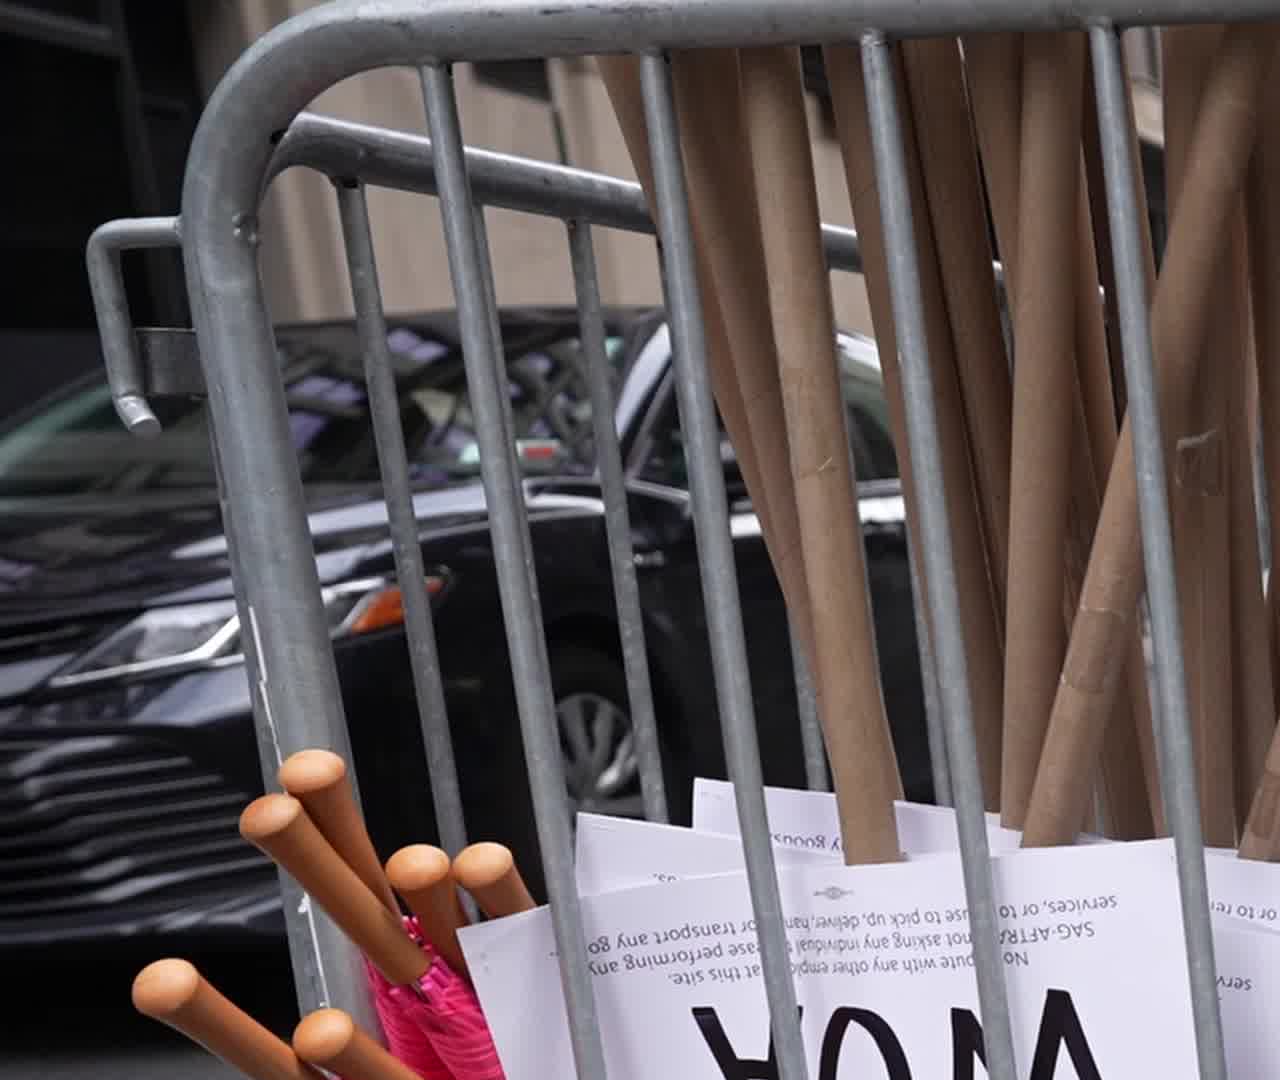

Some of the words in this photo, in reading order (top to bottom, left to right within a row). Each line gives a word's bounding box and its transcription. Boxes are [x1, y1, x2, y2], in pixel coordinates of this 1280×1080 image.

[999, 905, 1016, 919] to
[1023, 903, 1039, 918] or
[1043, 895, 1117, 916] services,
[1237, 905, 1253, 920] to
[862, 913, 886, 930] up,
[890, 909, 920, 930] pick
[925, 911, 941, 927] to
[1258, 909, 1277, 922] or
[654, 920, 736, 944] transport
[617, 933, 648, 951] any
[863, 933, 889, 952] any
[892, 933, 941, 953] asking
[946, 932, 971, 952] not
[624, 944, 722, 970] performing
[873, 955, 898, 974] any
[902, 956, 937, 975] with
[1003, 950, 1029, 966] No
[588, 960, 618, 978] any
[668, 969, 704, 985] site.
[708, 968, 740, 982] this
[744, 965, 760, 979] at
[831, 960, 869, 978] other
